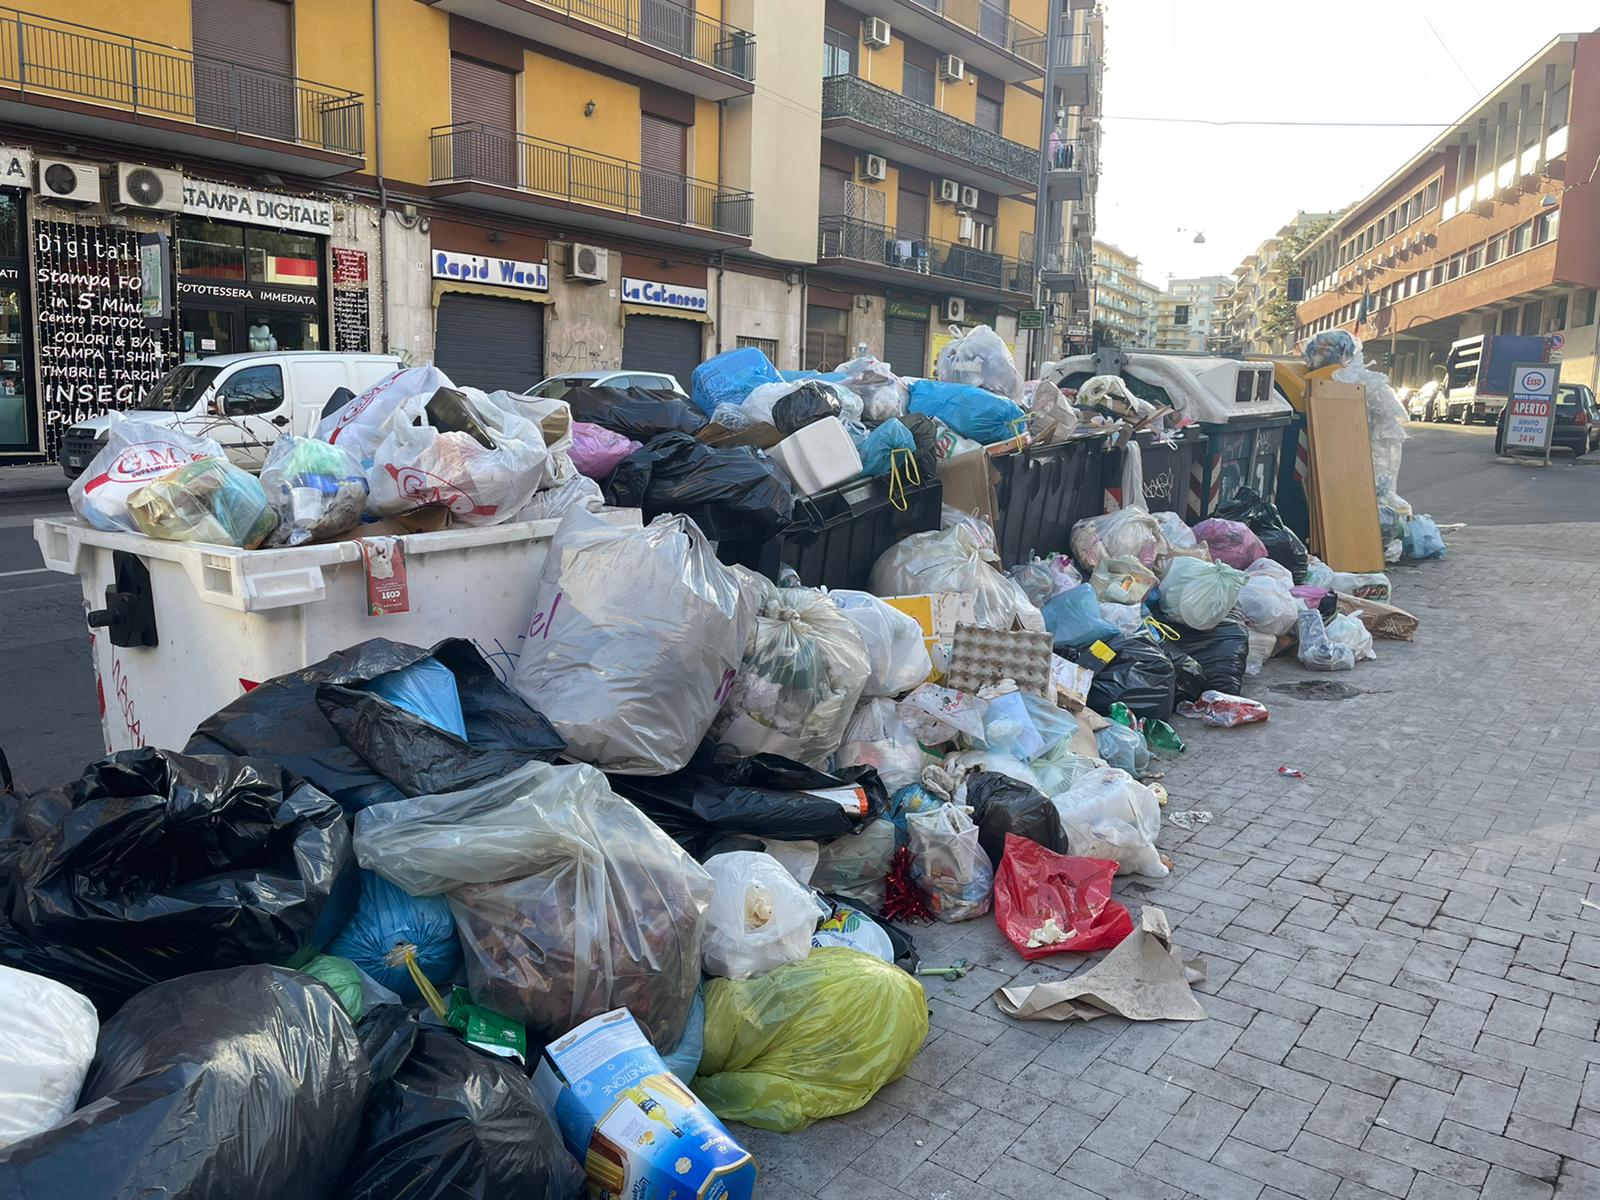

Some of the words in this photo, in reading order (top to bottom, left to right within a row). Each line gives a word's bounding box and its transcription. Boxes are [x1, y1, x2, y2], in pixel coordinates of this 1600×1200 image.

[256, 199, 330, 227] DIGITALE
[436, 252, 489, 281] Rapid
[38, 268, 111, 291] Stampa
[623, 278, 640, 299] La
[51, 291, 69, 308] in
[77, 292, 96, 309] 5
[176, 282, 254, 300] FOTOTESSERA
[260, 291, 318, 306] IMMEDIATA
[38, 310, 86, 325] Centro
[54, 331, 109, 346] COLORI
[114, 335, 126, 347] &
[41, 345, 105, 362] STAMPA
[108, 349, 168, 363] T-SHIRT
[41, 365, 93, 378] TIMBRI
[98, 367, 107, 379] E
[1526, 376, 1542, 386] Esso
[1513, 402, 1547, 416] APERTO
